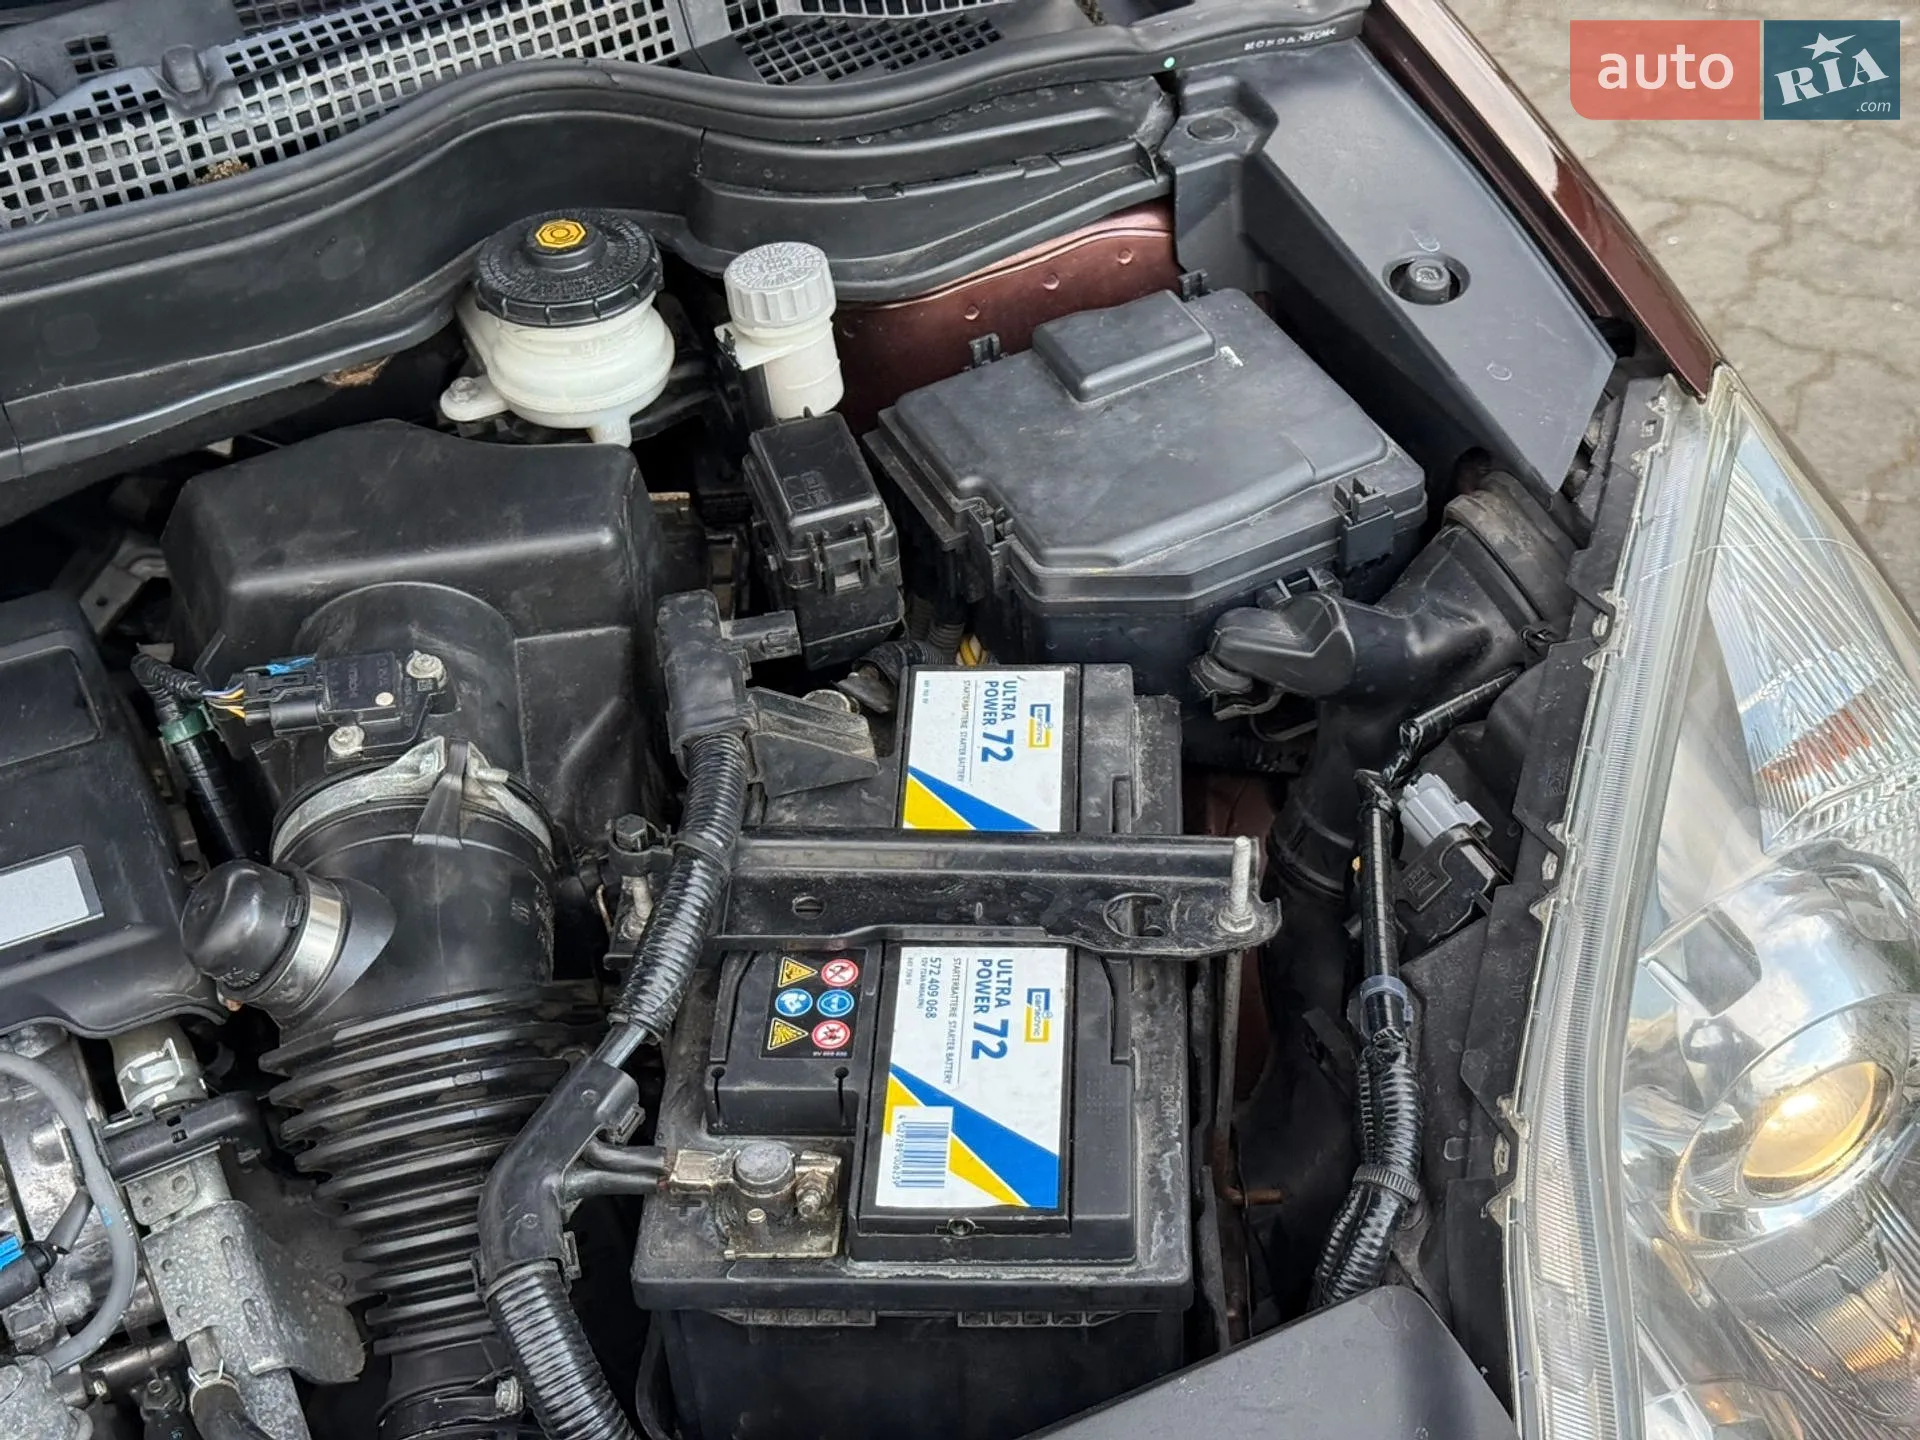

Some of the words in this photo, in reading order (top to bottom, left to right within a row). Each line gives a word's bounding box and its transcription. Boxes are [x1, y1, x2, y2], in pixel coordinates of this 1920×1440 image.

[982, 680, 999, 726] POWER
[1001, 680, 1017, 721] ULTRA
[981, 729, 1015, 763] 72
[927, 977, 940, 997] 409
[929, 957, 942, 976] 572
[973, 958, 993, 1014] POWER
[994, 958, 1013, 1009] ULTRA
[949, 957, 962, 1018] STARTERBATTERIE
[925, 999, 938, 1019] 068
[1032, 994, 1042, 1037] cartechnic
[946, 1020, 958, 1051] STARTER
[971, 1018, 1009, 1060] 72
[943, 1052, 955, 1085] BATTERY
